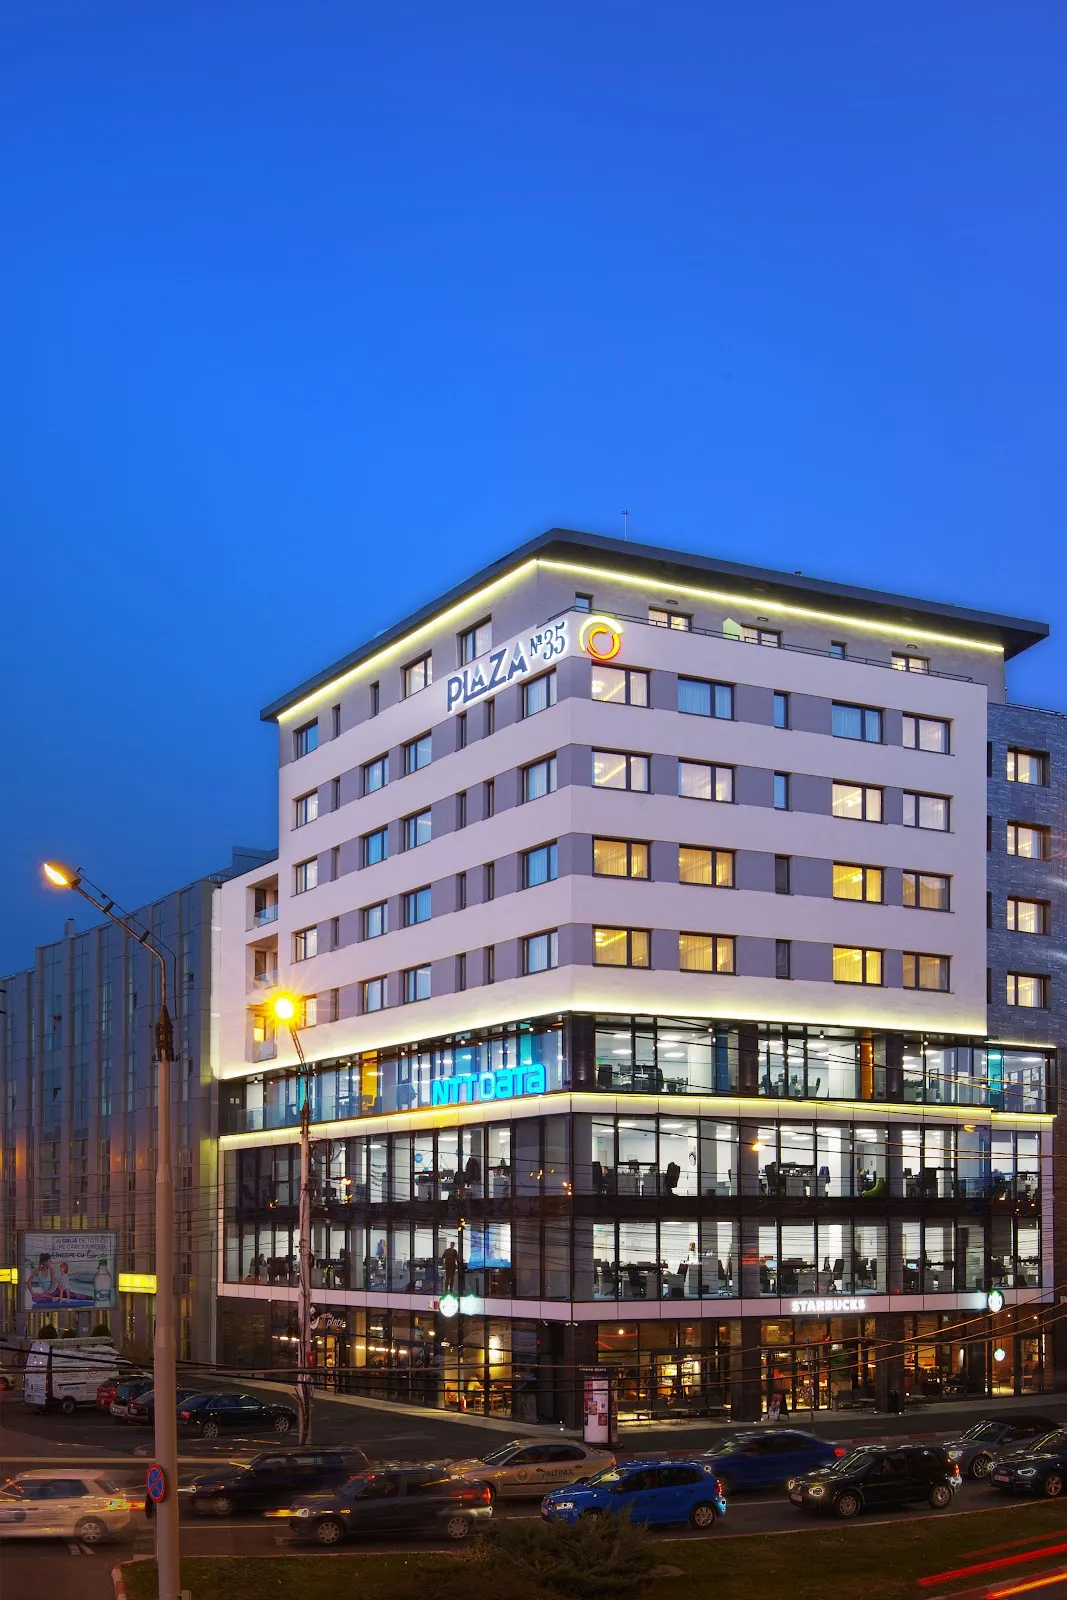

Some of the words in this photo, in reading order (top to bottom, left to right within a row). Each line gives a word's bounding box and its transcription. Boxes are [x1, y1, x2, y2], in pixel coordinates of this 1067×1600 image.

[447, 641, 528, 712] PLAZA
[543, 621, 566, 660] 35
[432, 1073, 477, 1107] NTT
[791, 1299, 866, 1313] STARBUCKS
